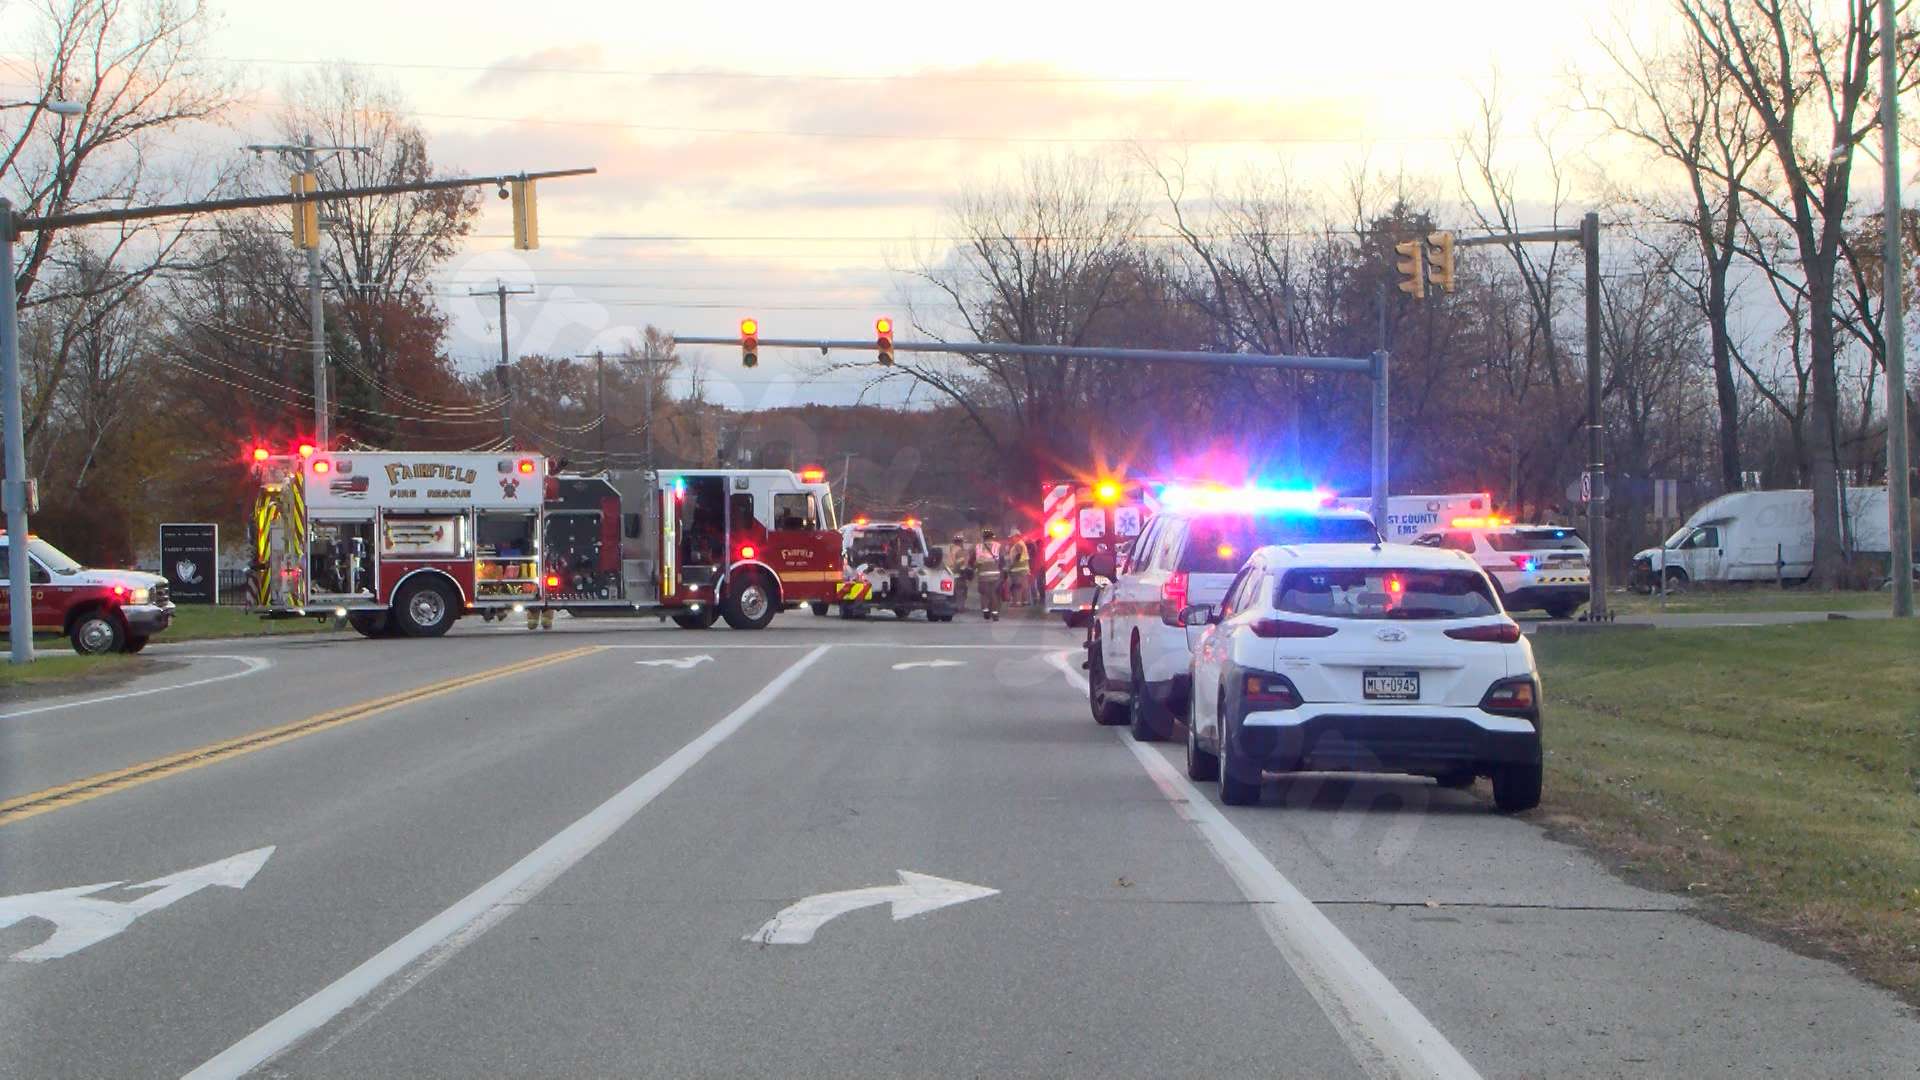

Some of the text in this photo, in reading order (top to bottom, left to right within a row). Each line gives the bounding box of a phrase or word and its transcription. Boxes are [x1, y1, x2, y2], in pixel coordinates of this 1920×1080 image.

[384, 462, 477, 486] FAIRFIELD
[389, 489, 472, 499] FIRE RESCUE
[1402, 513, 1438, 524] COUNTY
[1397, 525, 1418, 535] EMS
